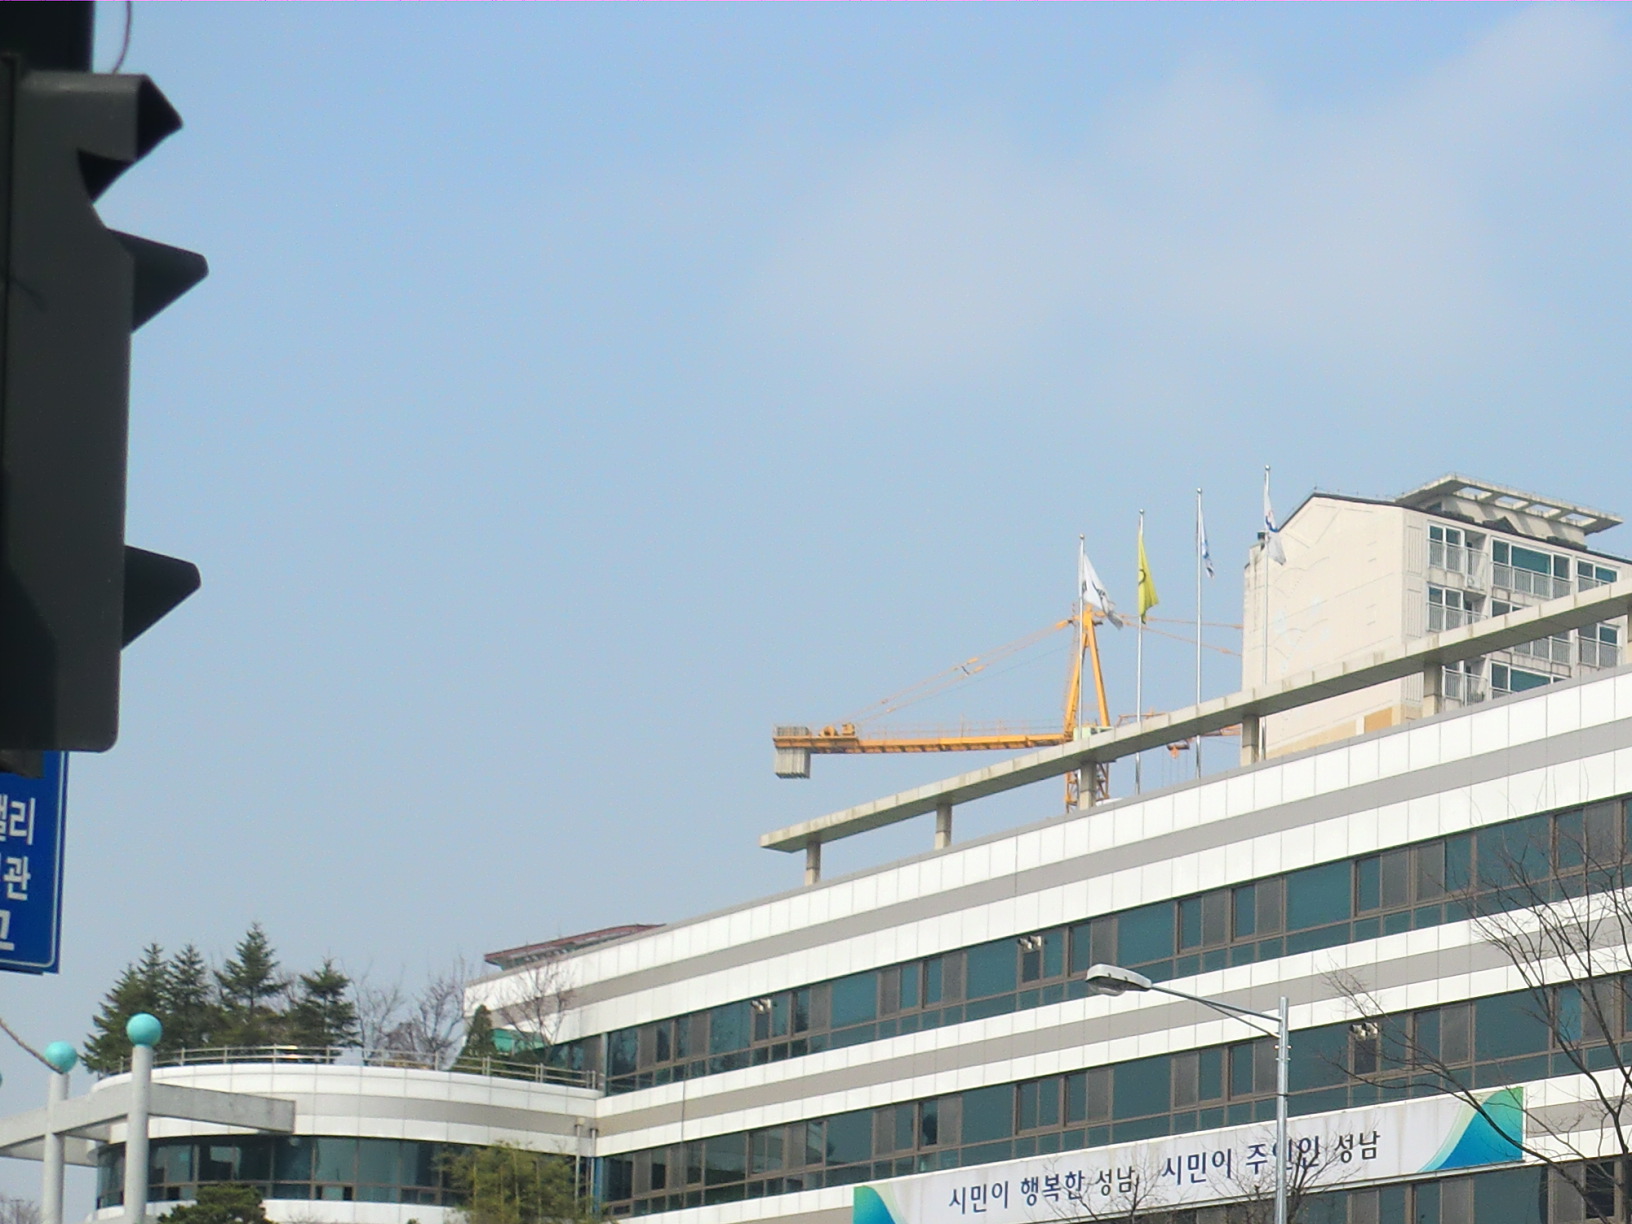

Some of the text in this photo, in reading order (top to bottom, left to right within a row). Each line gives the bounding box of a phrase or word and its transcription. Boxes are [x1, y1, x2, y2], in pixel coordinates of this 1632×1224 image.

[949, 1180, 1010, 1214] 시민이
[1021, 1170, 1085, 1206] 행복한
[1095, 1165, 1136, 1197] 성남
[1162, 1148, 1233, 1186] 시민이
[1334, 1130, 1381, 1164] 성남
